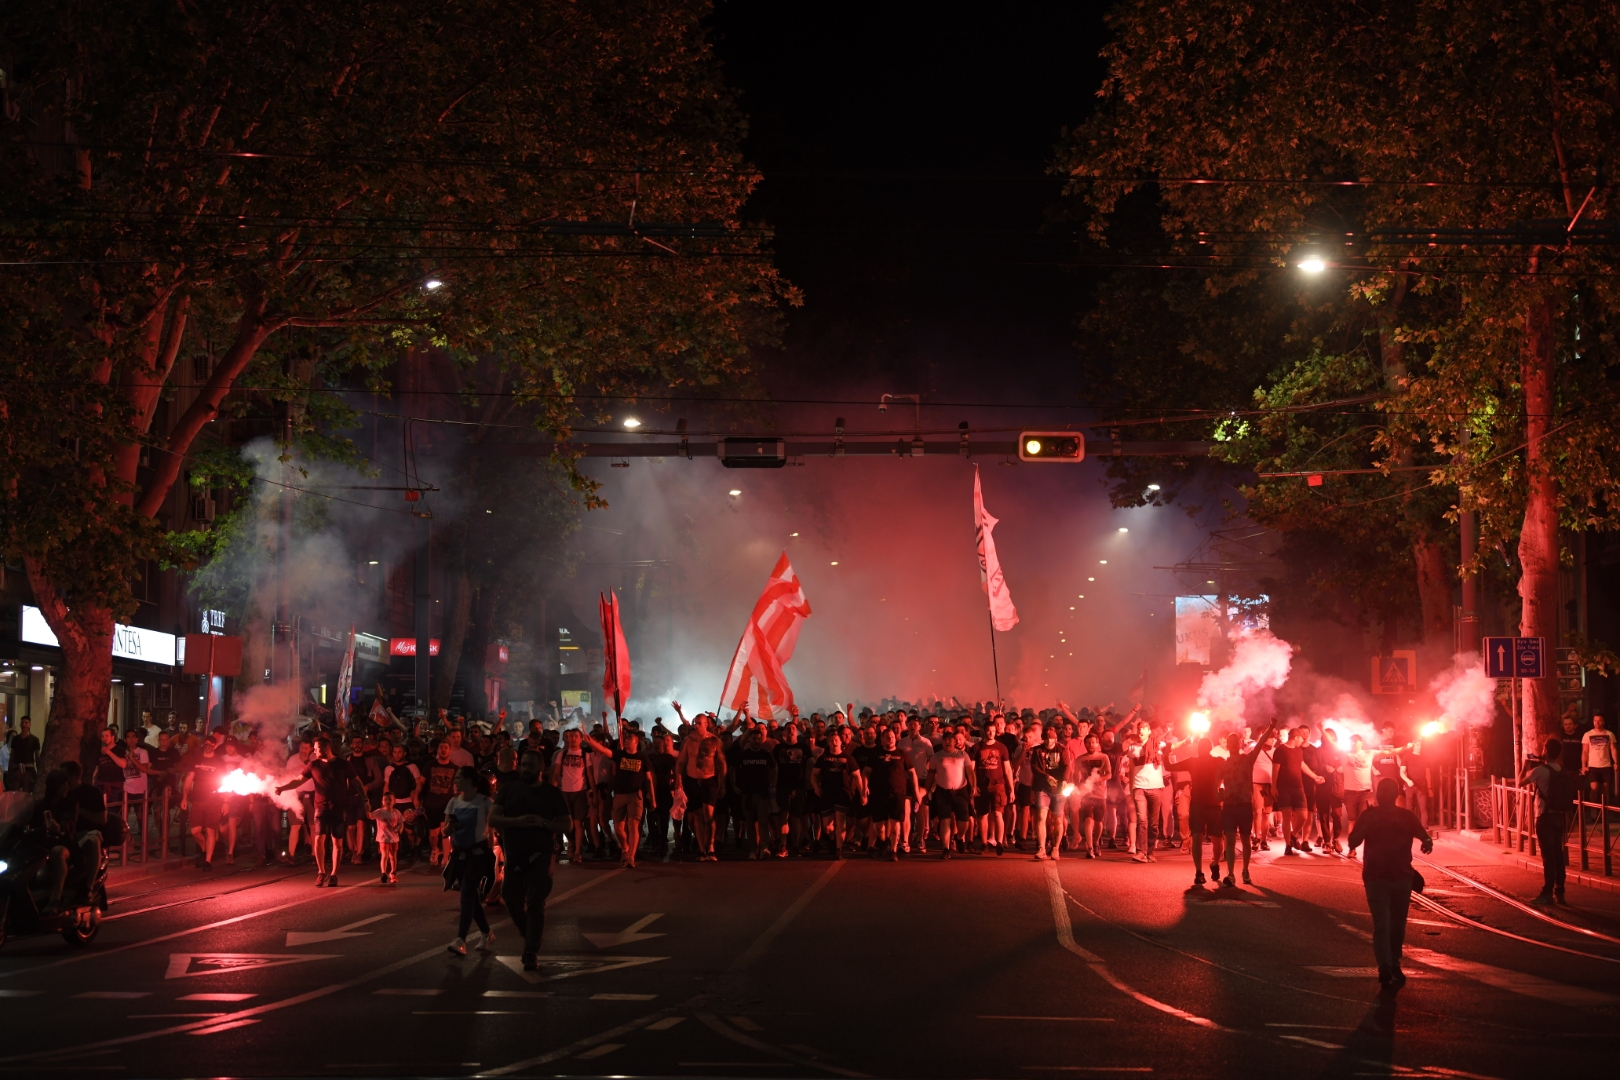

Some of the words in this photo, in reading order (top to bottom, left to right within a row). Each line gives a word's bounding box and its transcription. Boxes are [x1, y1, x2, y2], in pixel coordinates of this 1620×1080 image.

[114, 626, 142, 656] INTESA
[1176, 628, 1209, 644] UKUS
[395, 641, 410, 653] Moj
